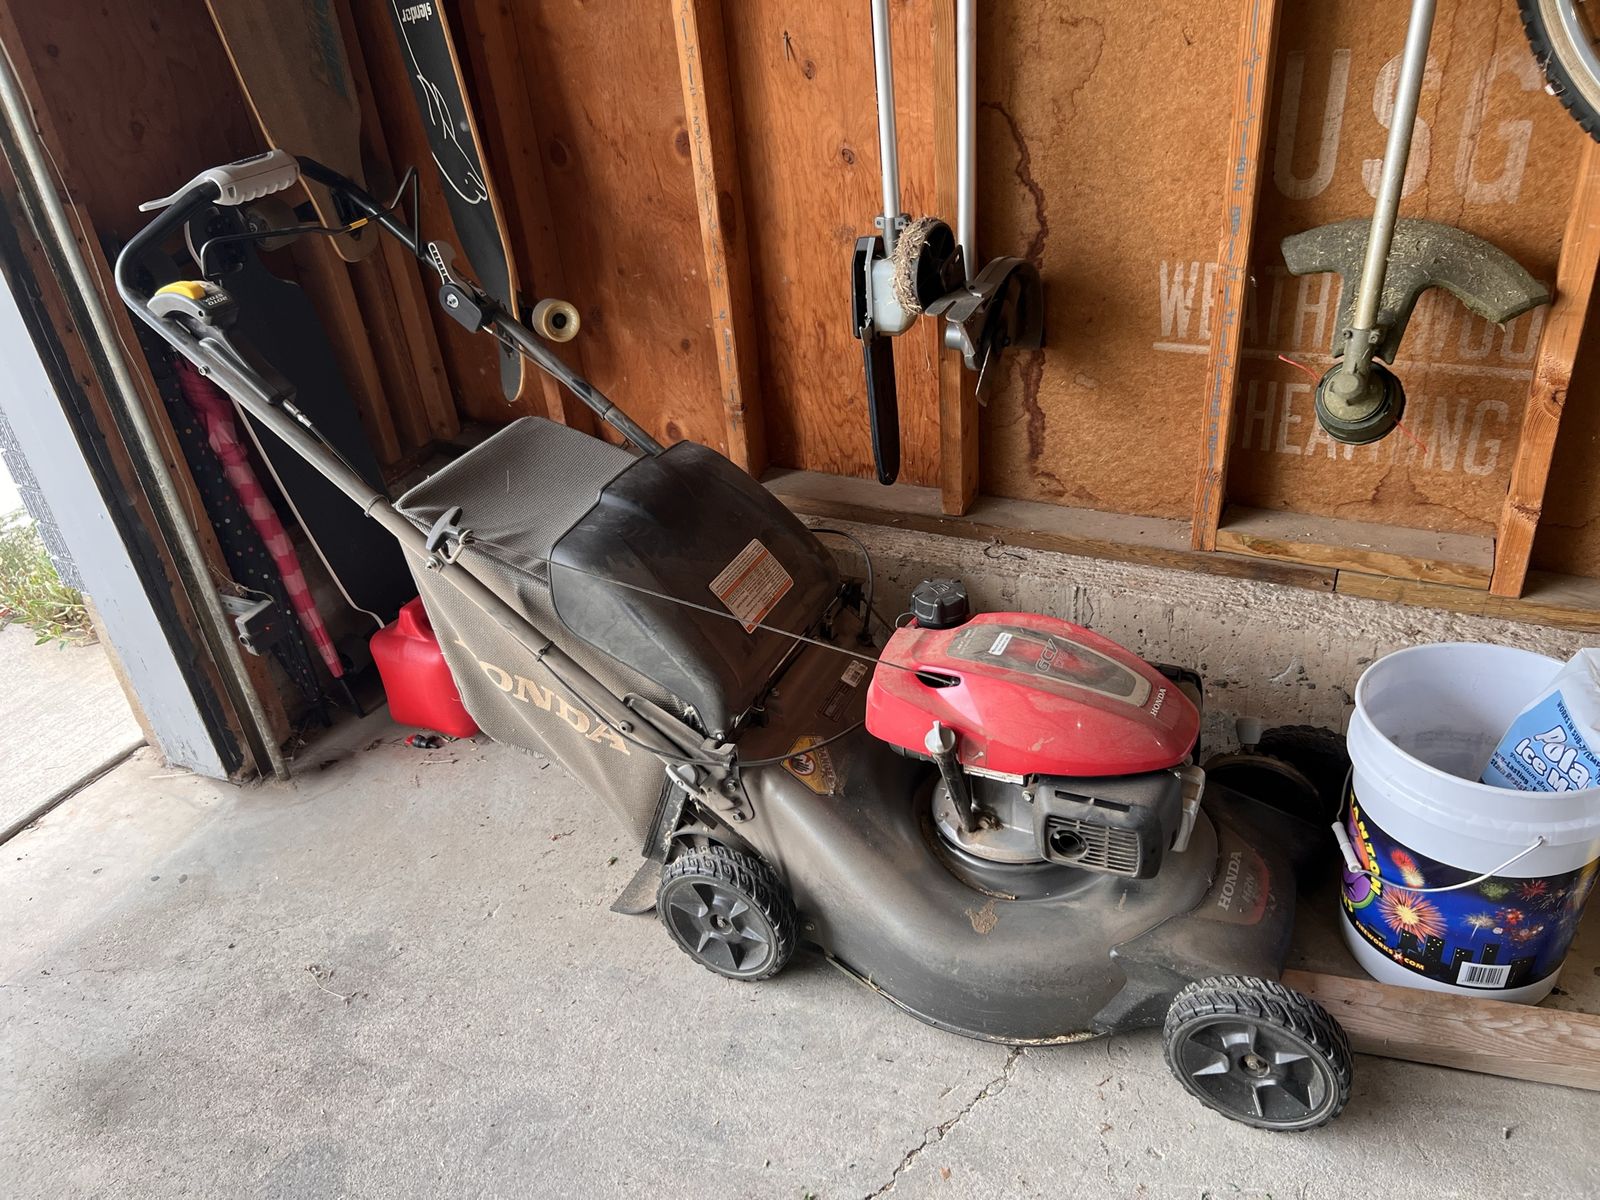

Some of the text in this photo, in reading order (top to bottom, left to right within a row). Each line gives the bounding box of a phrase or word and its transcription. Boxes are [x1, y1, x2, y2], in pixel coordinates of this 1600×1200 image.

[1273, 47, 1542, 204] USG
[455, 639, 630, 756] ONDA
[1150, 687, 1166, 719] HONDA
[1557, 700, 1570, 724] WORKS
[1514, 737, 1547, 776] Ice
[1533, 724, 1592, 790] Pola
[1217, 851, 1242, 911] HONDA
